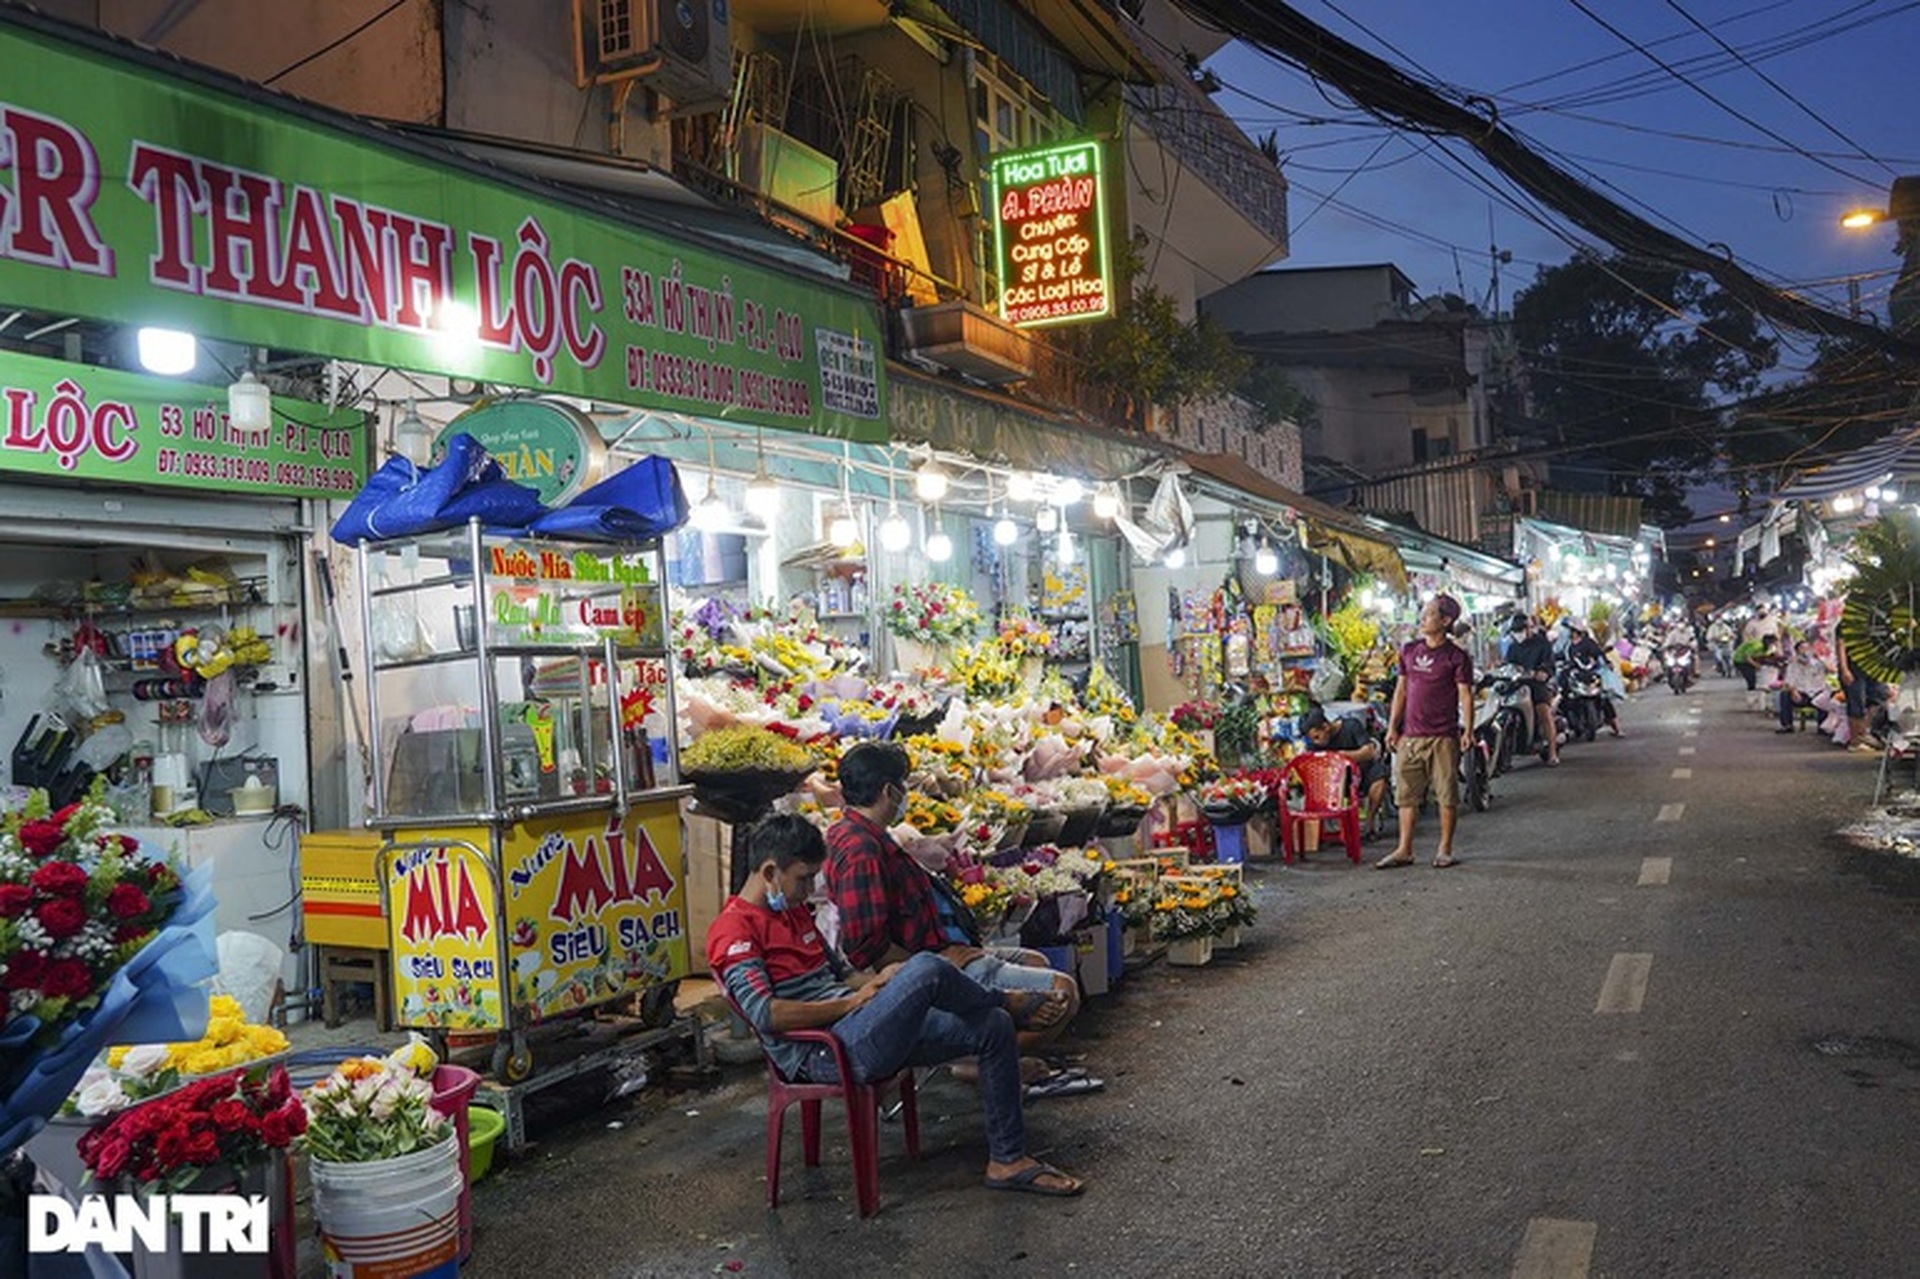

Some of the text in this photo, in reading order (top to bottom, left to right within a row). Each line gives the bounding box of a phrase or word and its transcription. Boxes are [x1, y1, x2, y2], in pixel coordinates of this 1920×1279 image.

[1003, 163, 1044, 185] Hoa
[0, 101, 116, 278] R
[127, 139, 456, 338] THANH
[468, 215, 607, 387] LỘC
[1011, 243, 1054, 264] Cung
[1040, 262, 1056, 280] &
[622, 265, 658, 327] 53A
[1003, 286, 1037, 306] Các
[1071, 277, 1105, 297] Hoa
[2, 378, 138, 471] LỘC
[160, 405, 183, 438] 53
[492, 547, 537, 578] Nước
[579, 597, 620, 627] Cam
[549, 816, 675, 924] MÍA
[402, 846, 488, 946] MÍA
[618, 909, 681, 952] SẠCH
